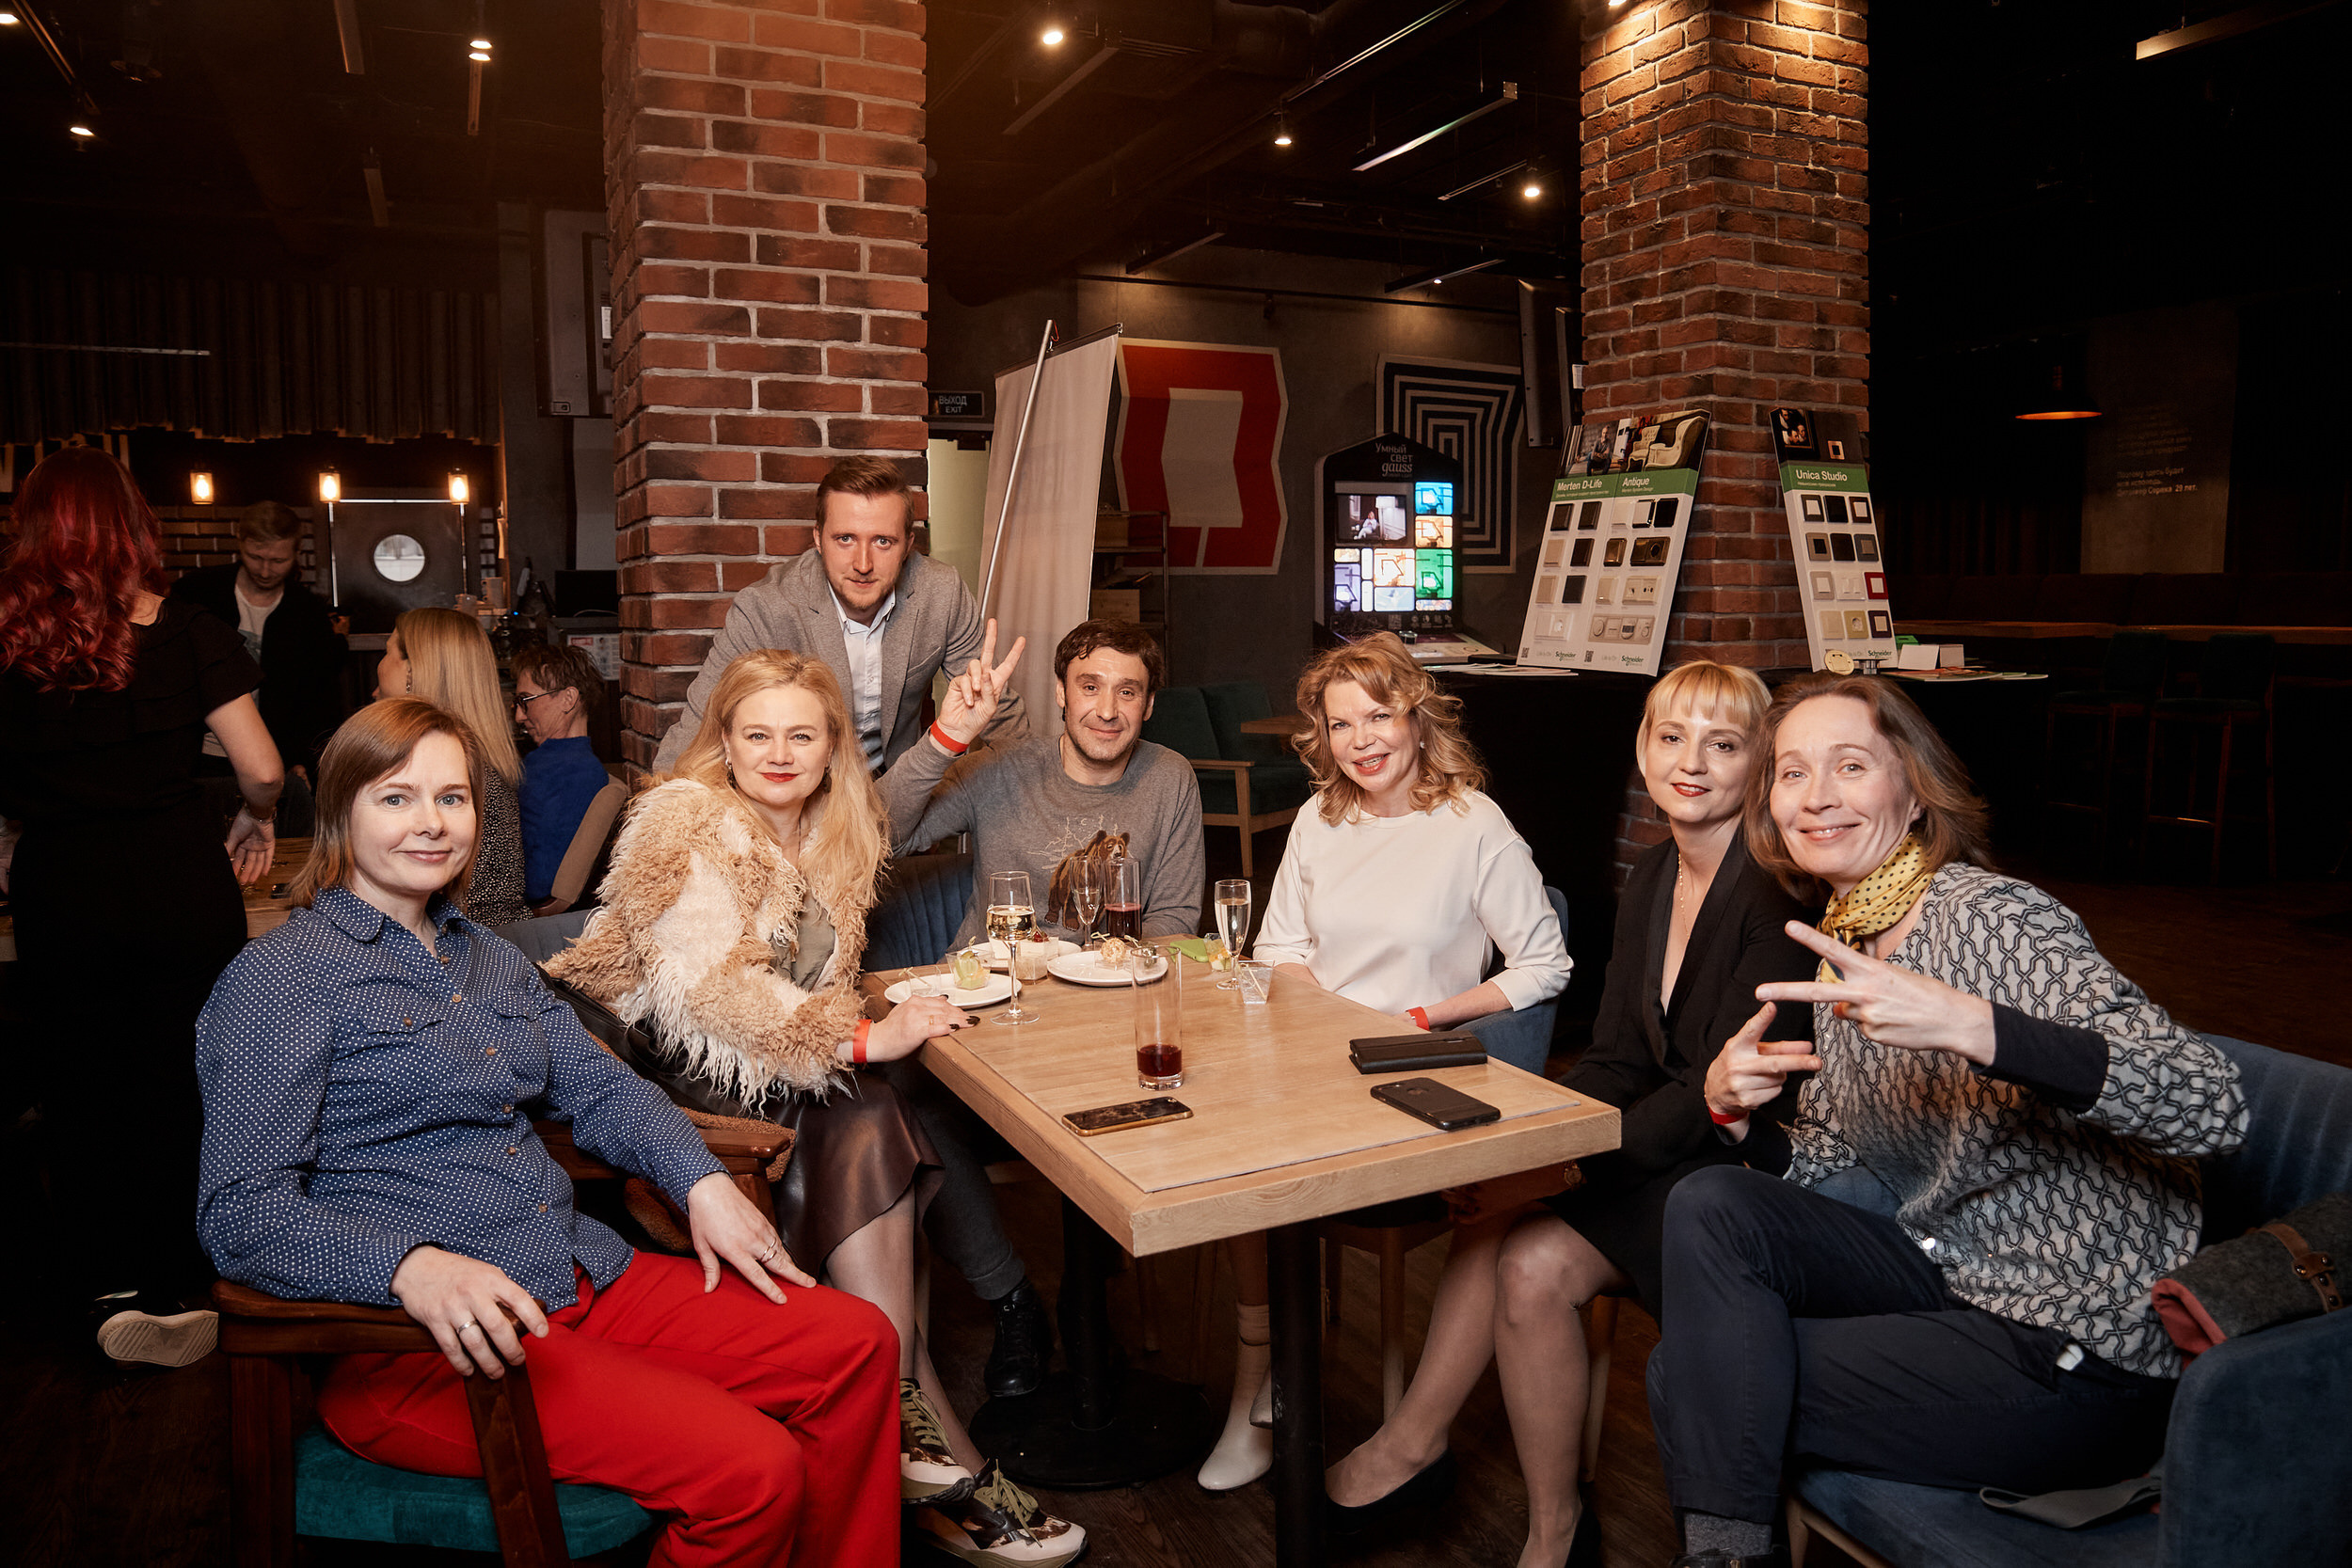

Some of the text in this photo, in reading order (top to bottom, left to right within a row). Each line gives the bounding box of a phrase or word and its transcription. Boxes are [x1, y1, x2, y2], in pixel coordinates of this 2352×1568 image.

[939, 395, 967, 406] ВЫХОД
[1375, 442, 1406, 453] Умный
[1391, 453, 1414, 463] свет
[1381, 462, 1413, 477] gauss
[1795, 468, 1848, 482] Unica Studio
[1557, 479, 1602, 491] Merten D-Life
[1622, 476, 1650, 488] Antique
[1555, 650, 1577, 659] Schneider
[1867, 649, 1892, 657] Schneider
[1621, 655, 1645, 664] Schneider
